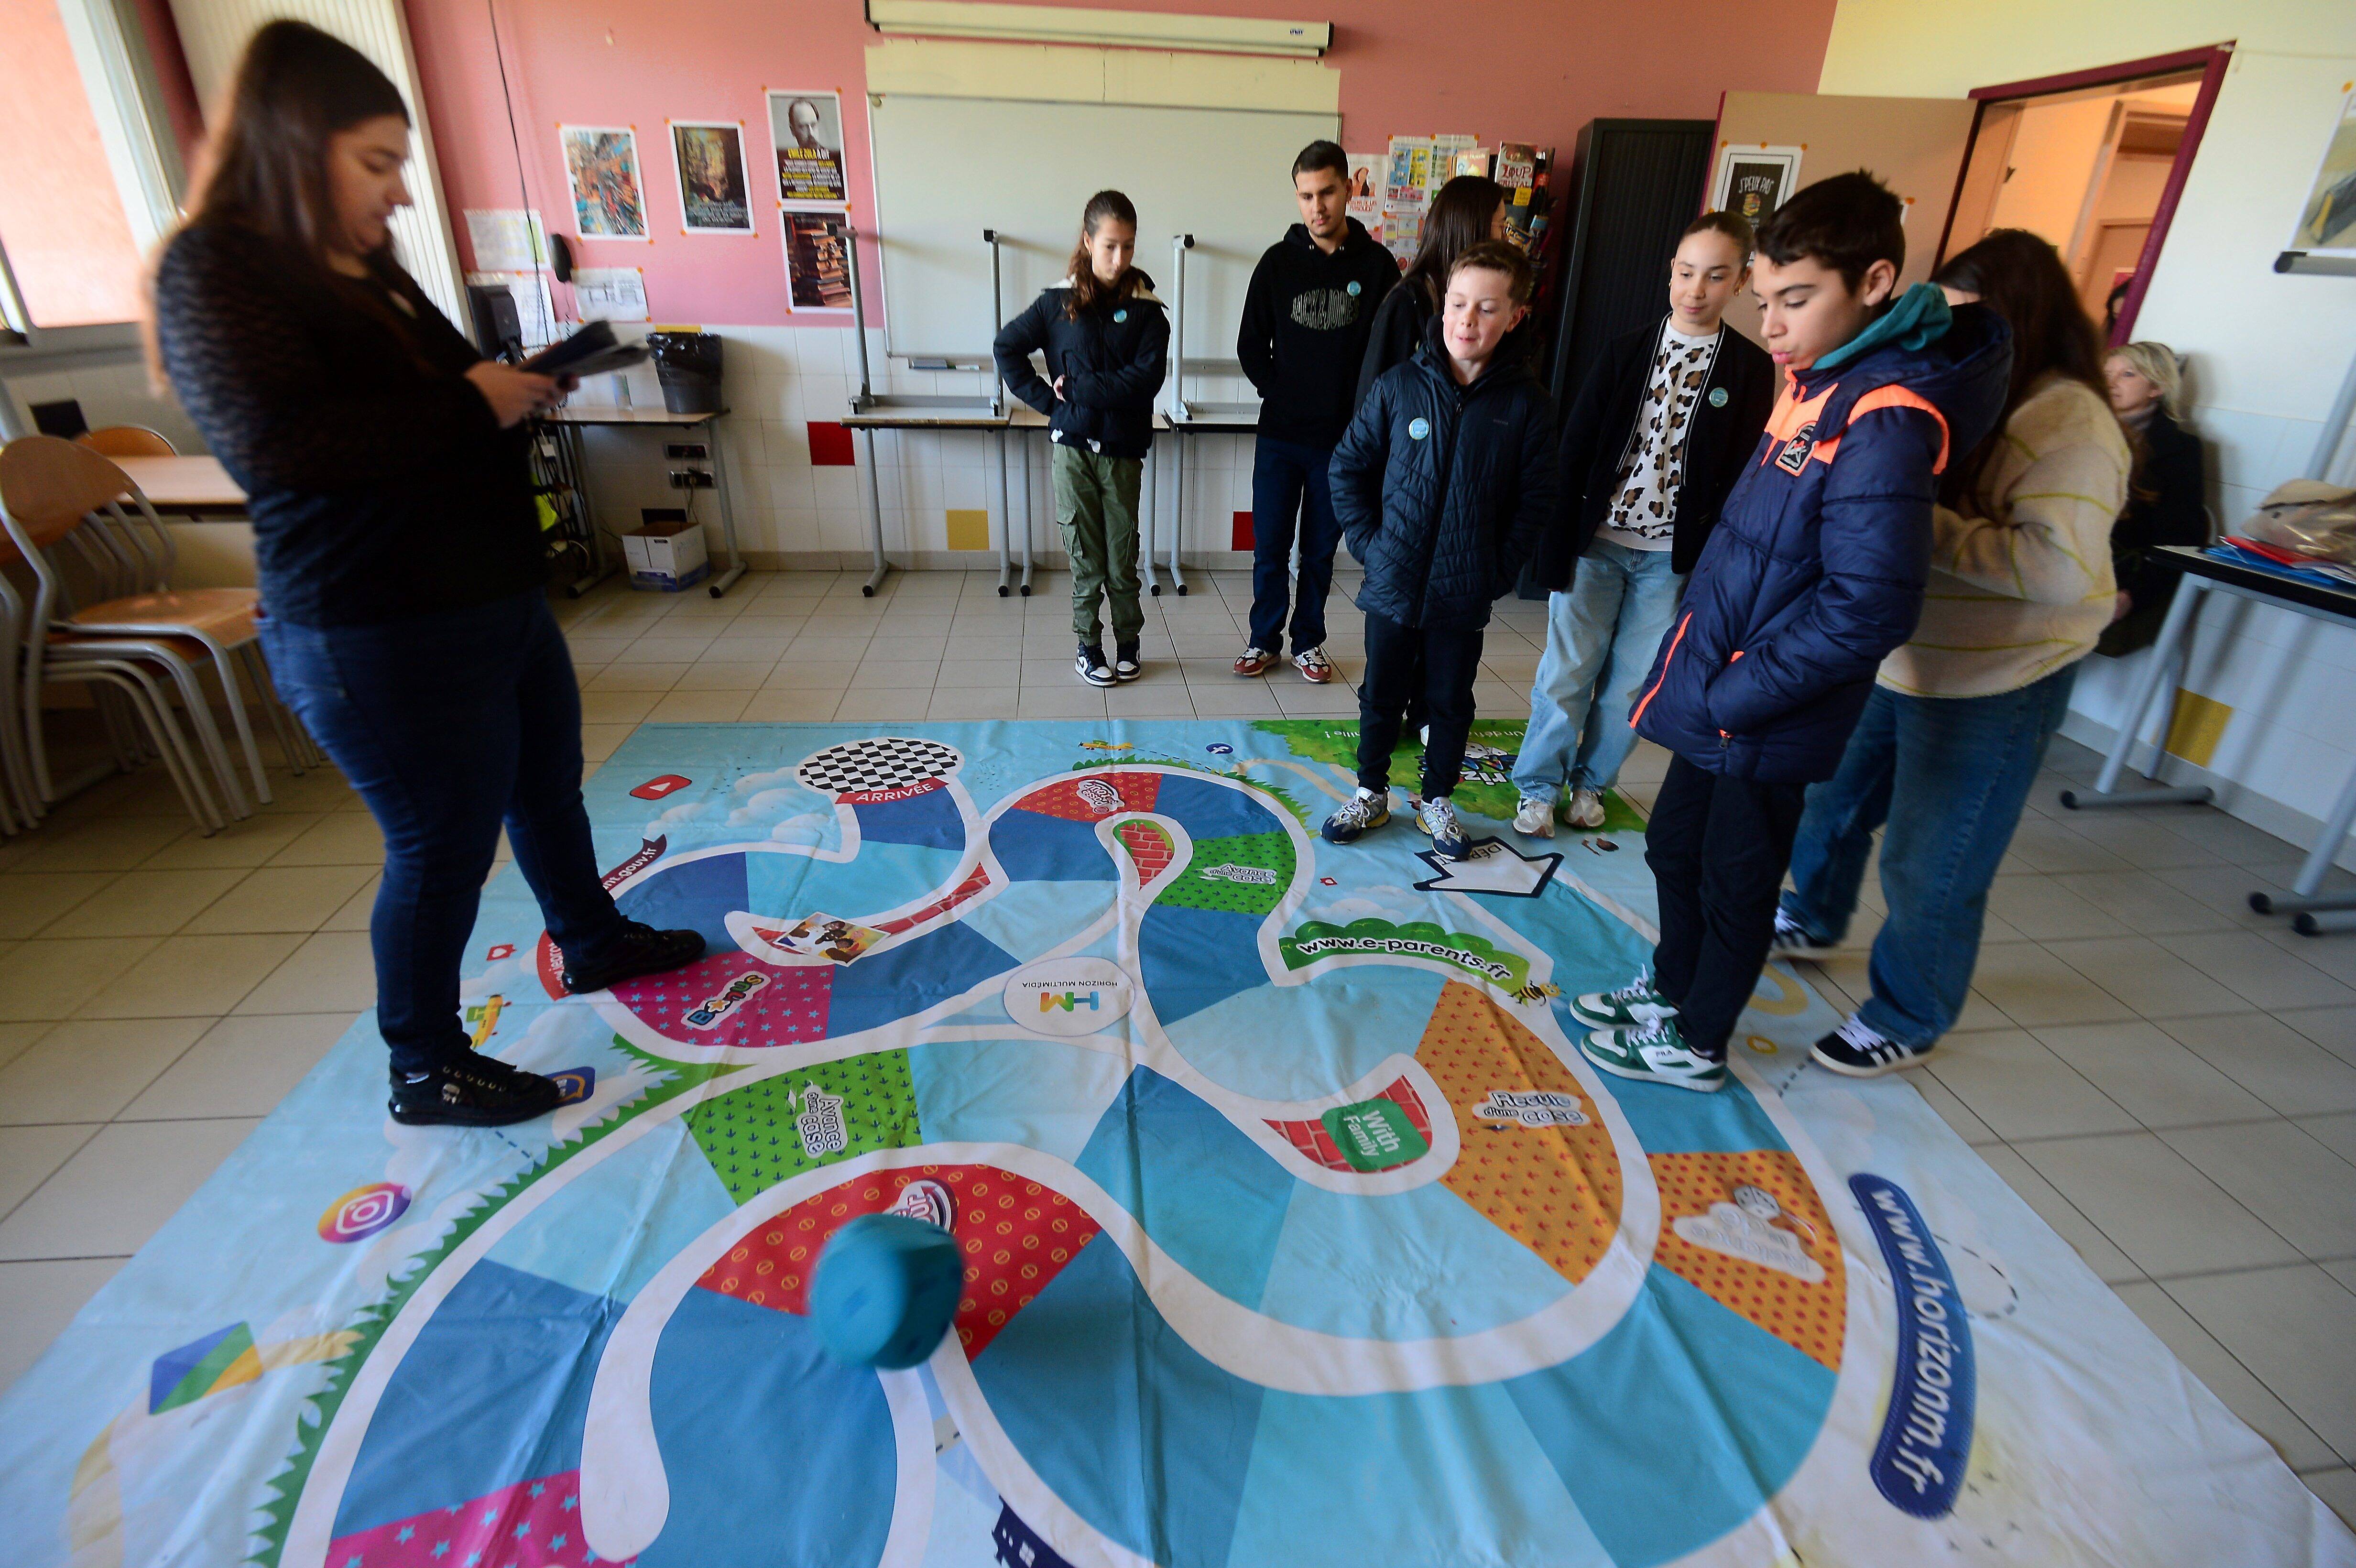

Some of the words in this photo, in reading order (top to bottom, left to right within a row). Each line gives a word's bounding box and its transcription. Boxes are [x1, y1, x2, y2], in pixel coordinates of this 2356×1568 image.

[856, 784, 934, 801] ARRIVÉE
[1221, 864, 1274, 877] Avance
[1299, 938, 1513, 980] www.e-parents.fr
[1492, 1092, 1571, 1108] Recule
[818, 1099, 842, 1149] Avance
[1343, 1115, 1380, 1157] Family
[1362, 1110, 1401, 1153] With
